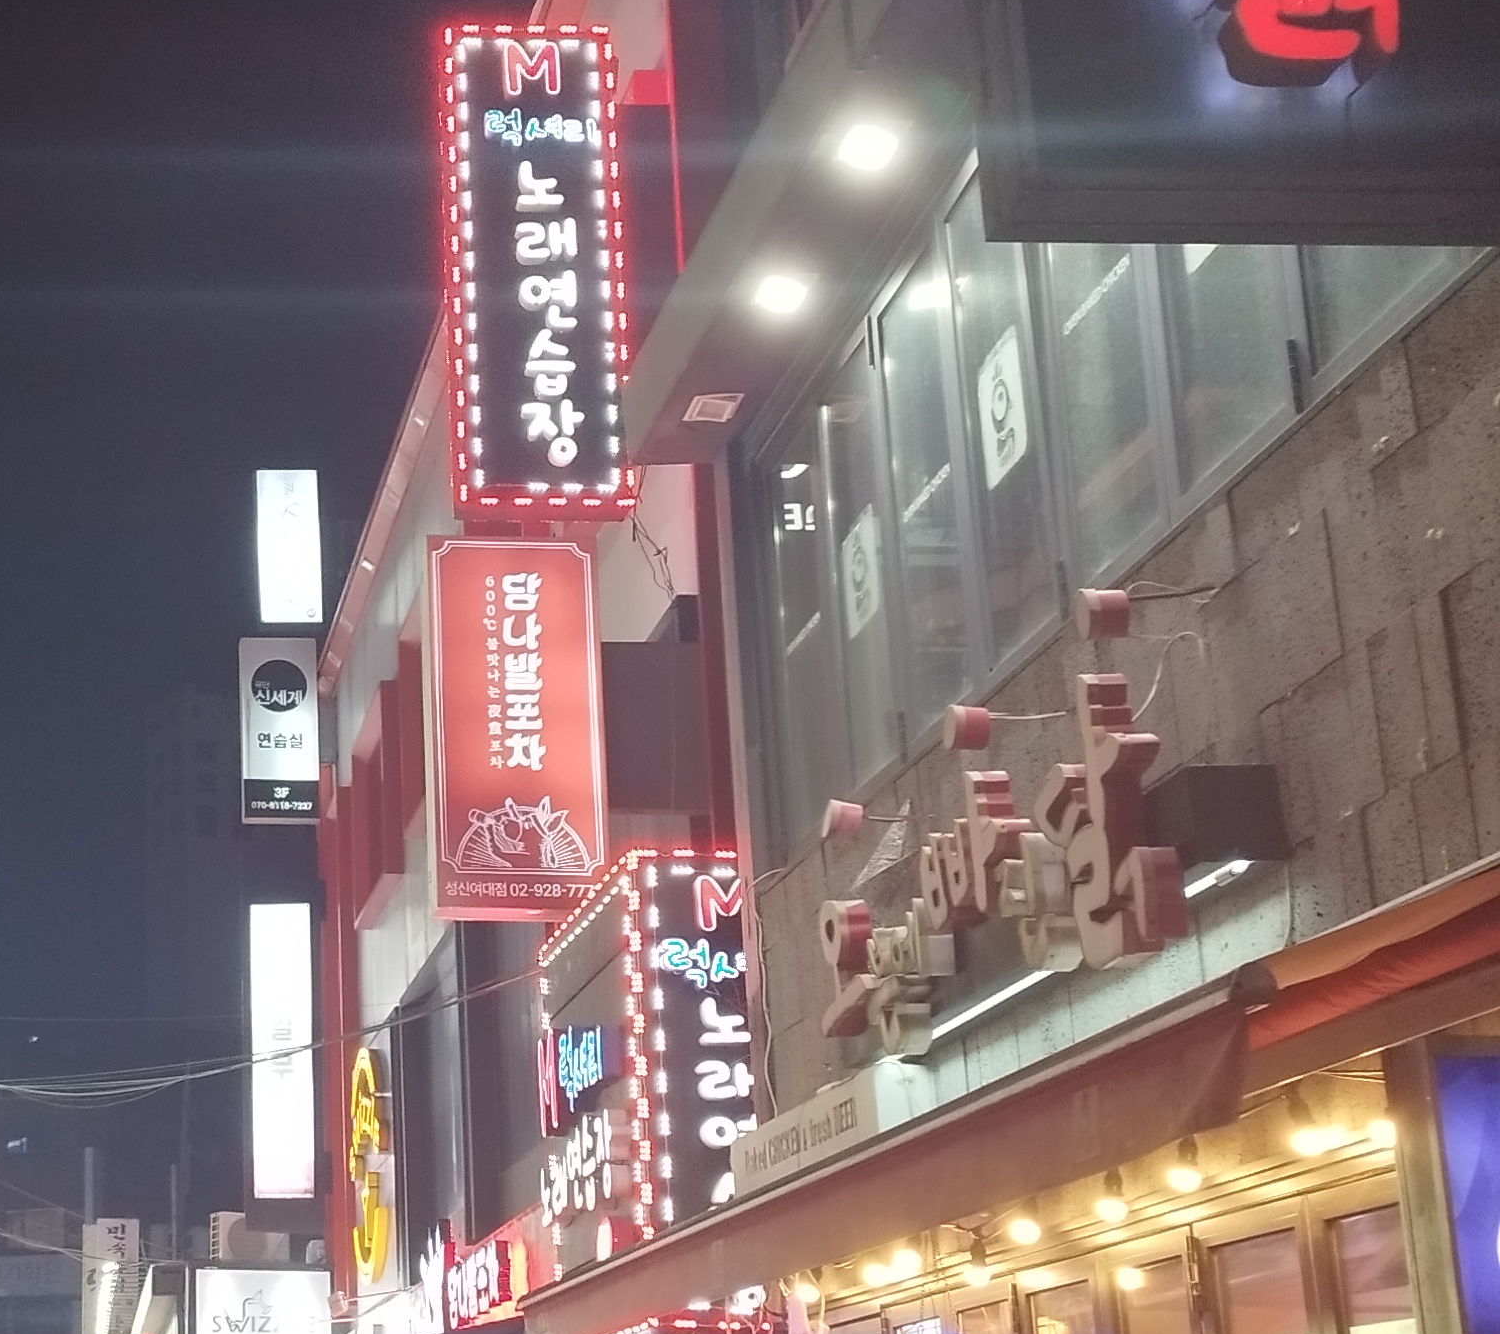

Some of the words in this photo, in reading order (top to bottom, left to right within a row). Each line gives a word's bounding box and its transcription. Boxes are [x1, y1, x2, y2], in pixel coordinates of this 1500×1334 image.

[515, 160, 586, 468] 노래연습장
[255, 689, 303, 707] 신세계
[274, 786, 290, 799] 3F
[445, 881, 507, 897] 성신여대점
